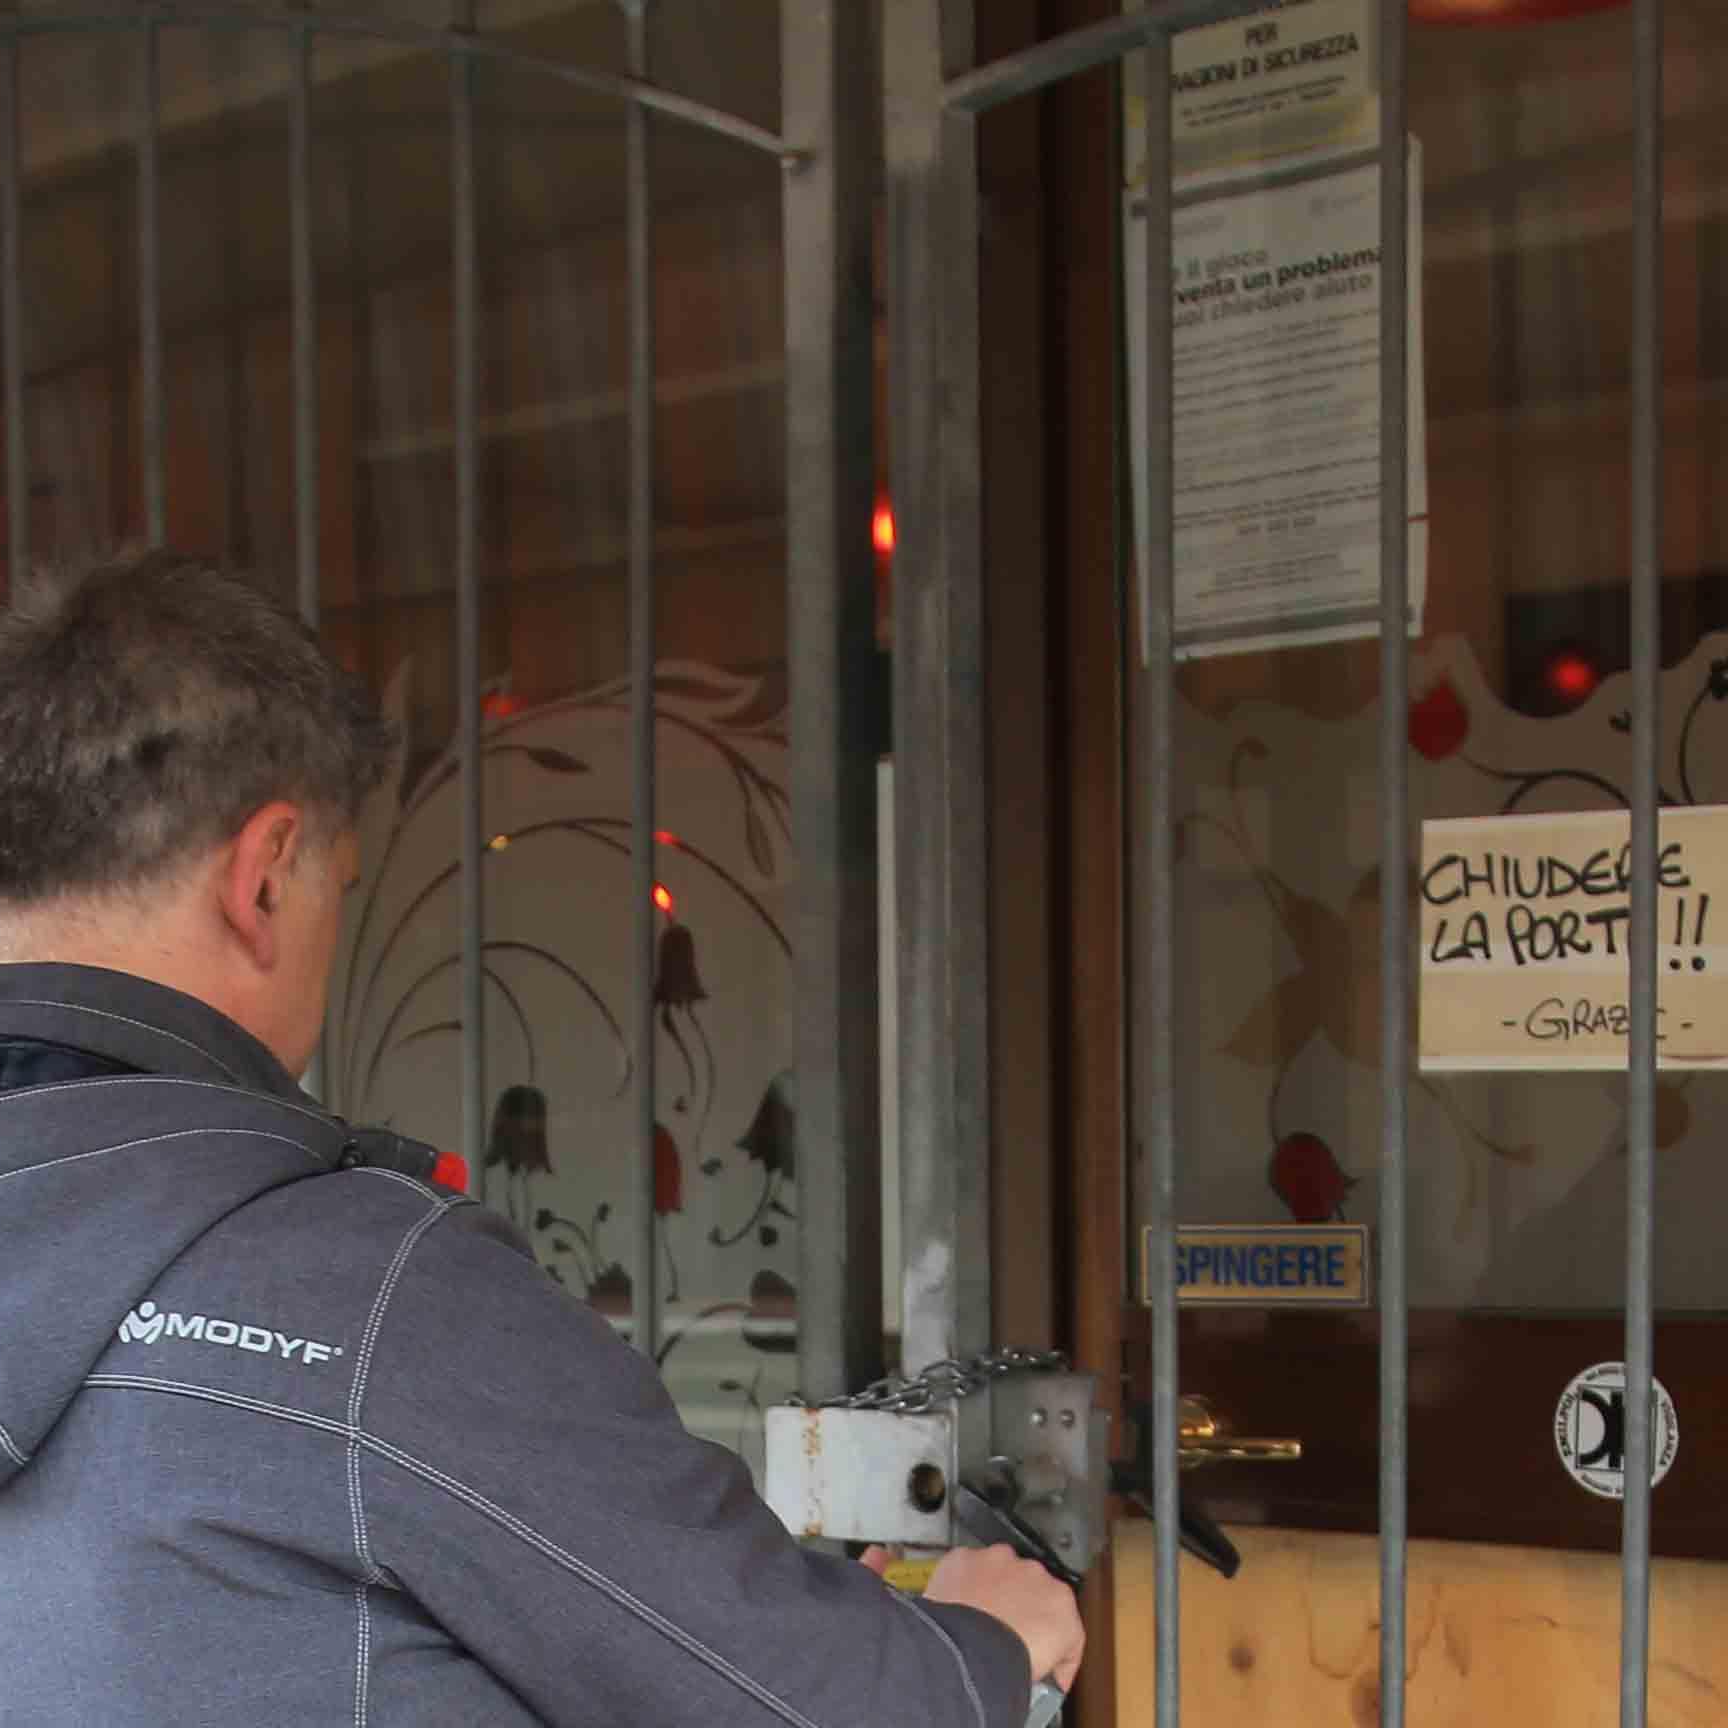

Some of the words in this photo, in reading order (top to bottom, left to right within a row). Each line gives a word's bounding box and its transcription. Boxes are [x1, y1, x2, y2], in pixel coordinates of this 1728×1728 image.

[1242, 57, 1259, 78] DI
[1264, 32, 1359, 70] SICUREZZA
[1243, 270, 1271, 290] un
[1431, 911, 1492, 963] LA
[1507, 893, 1710, 971] PORT!!
